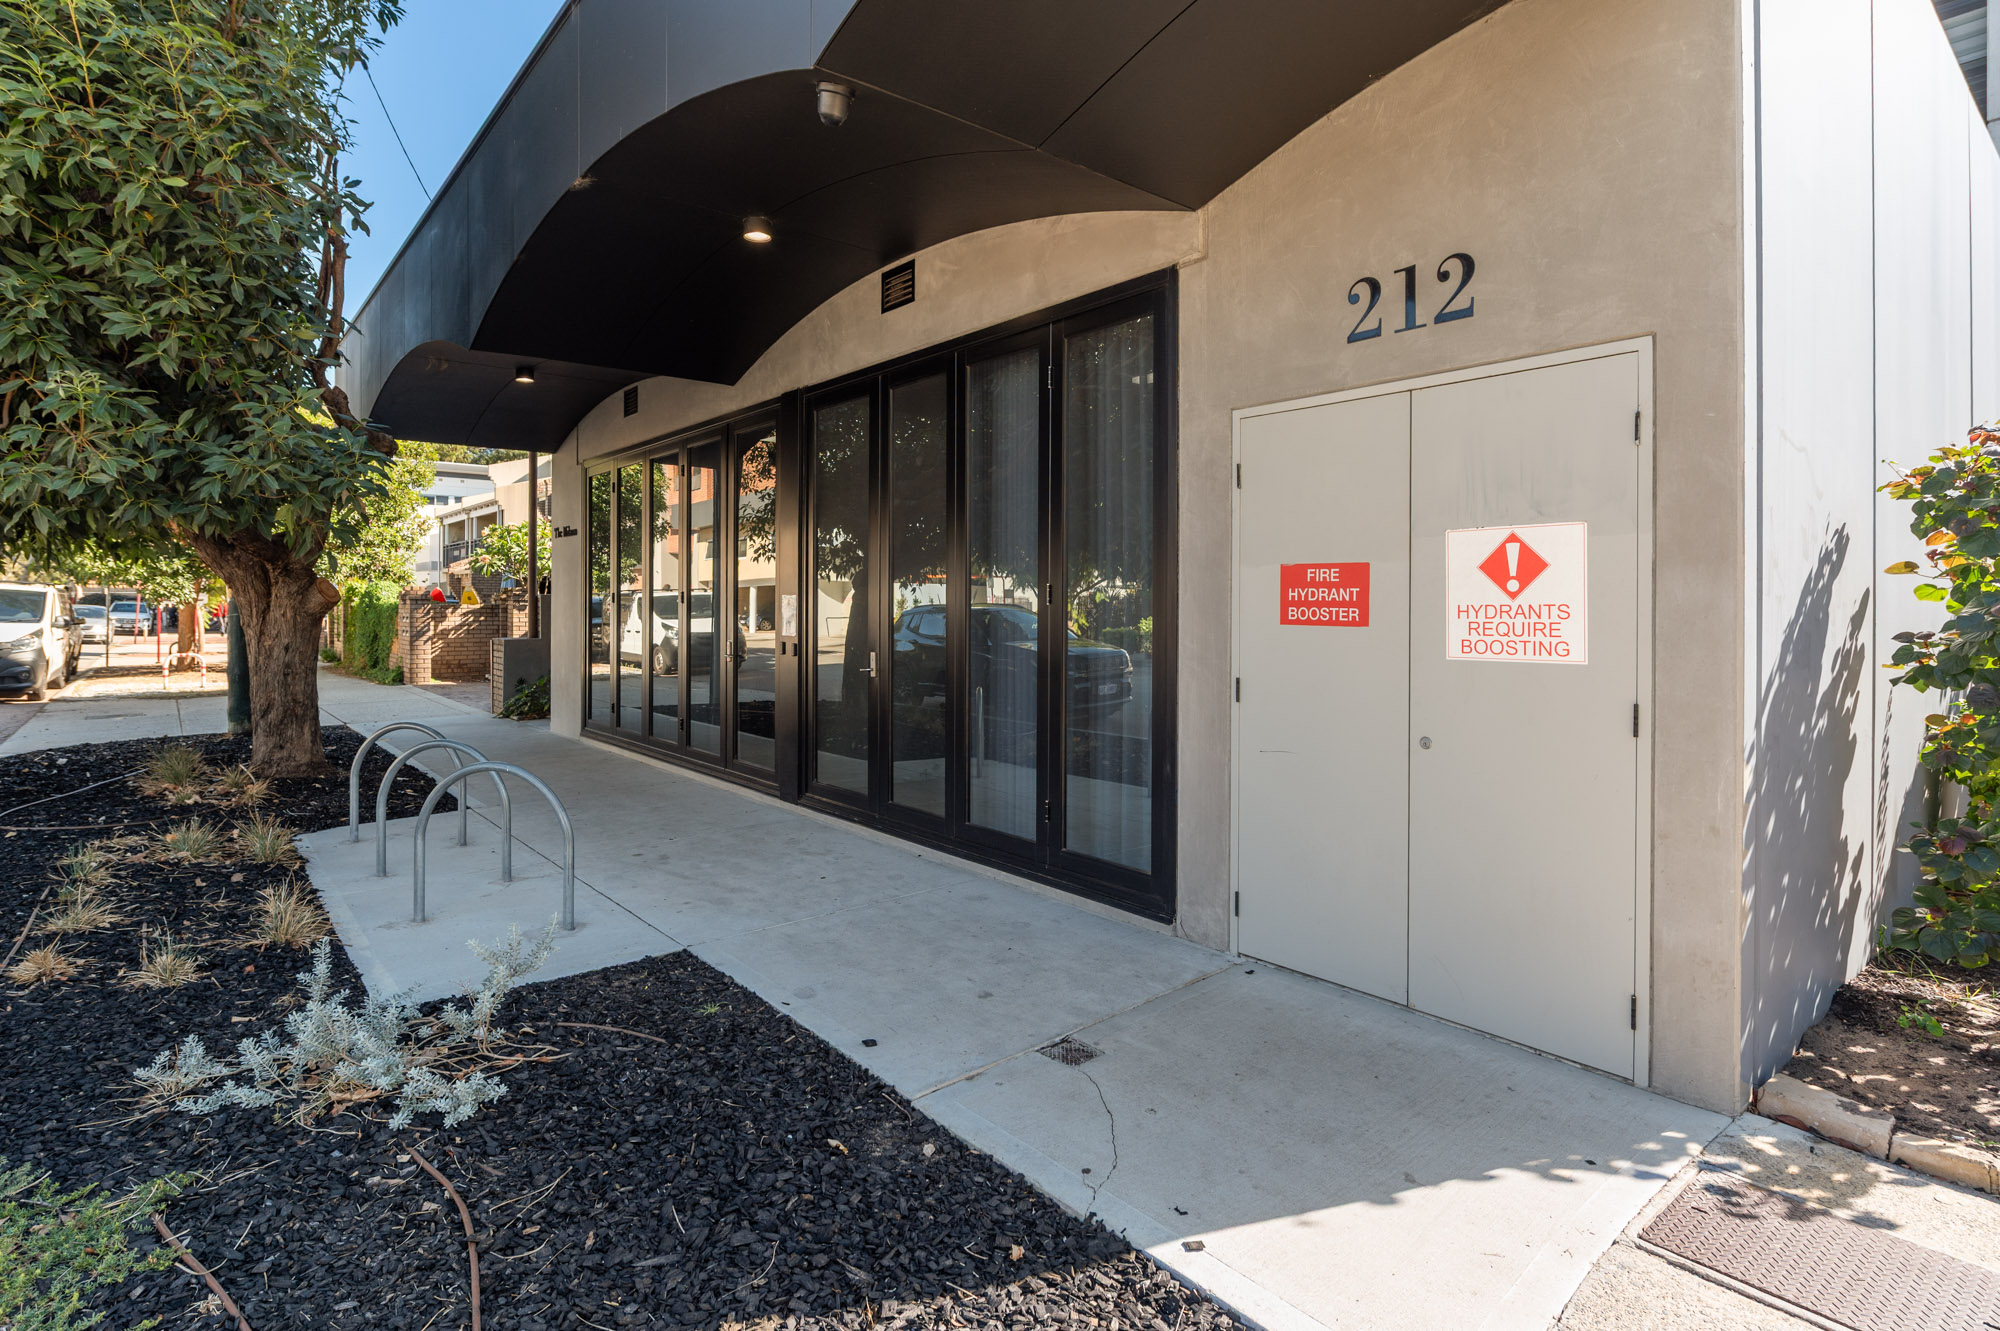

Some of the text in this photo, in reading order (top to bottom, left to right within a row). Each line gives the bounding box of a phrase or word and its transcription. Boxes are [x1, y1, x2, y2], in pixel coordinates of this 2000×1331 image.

[1347, 252, 1475, 344] 212
[1307, 568, 1340, 582] FIRE
[1288, 587, 1360, 601] HYDRANT
[1288, 607, 1359, 621] BOOSTER
[1457, 604, 1571, 620] HYDRANTS
[1468, 621, 1562, 637] REQUIRE
[1461, 639, 1570, 657] BOOSTING
